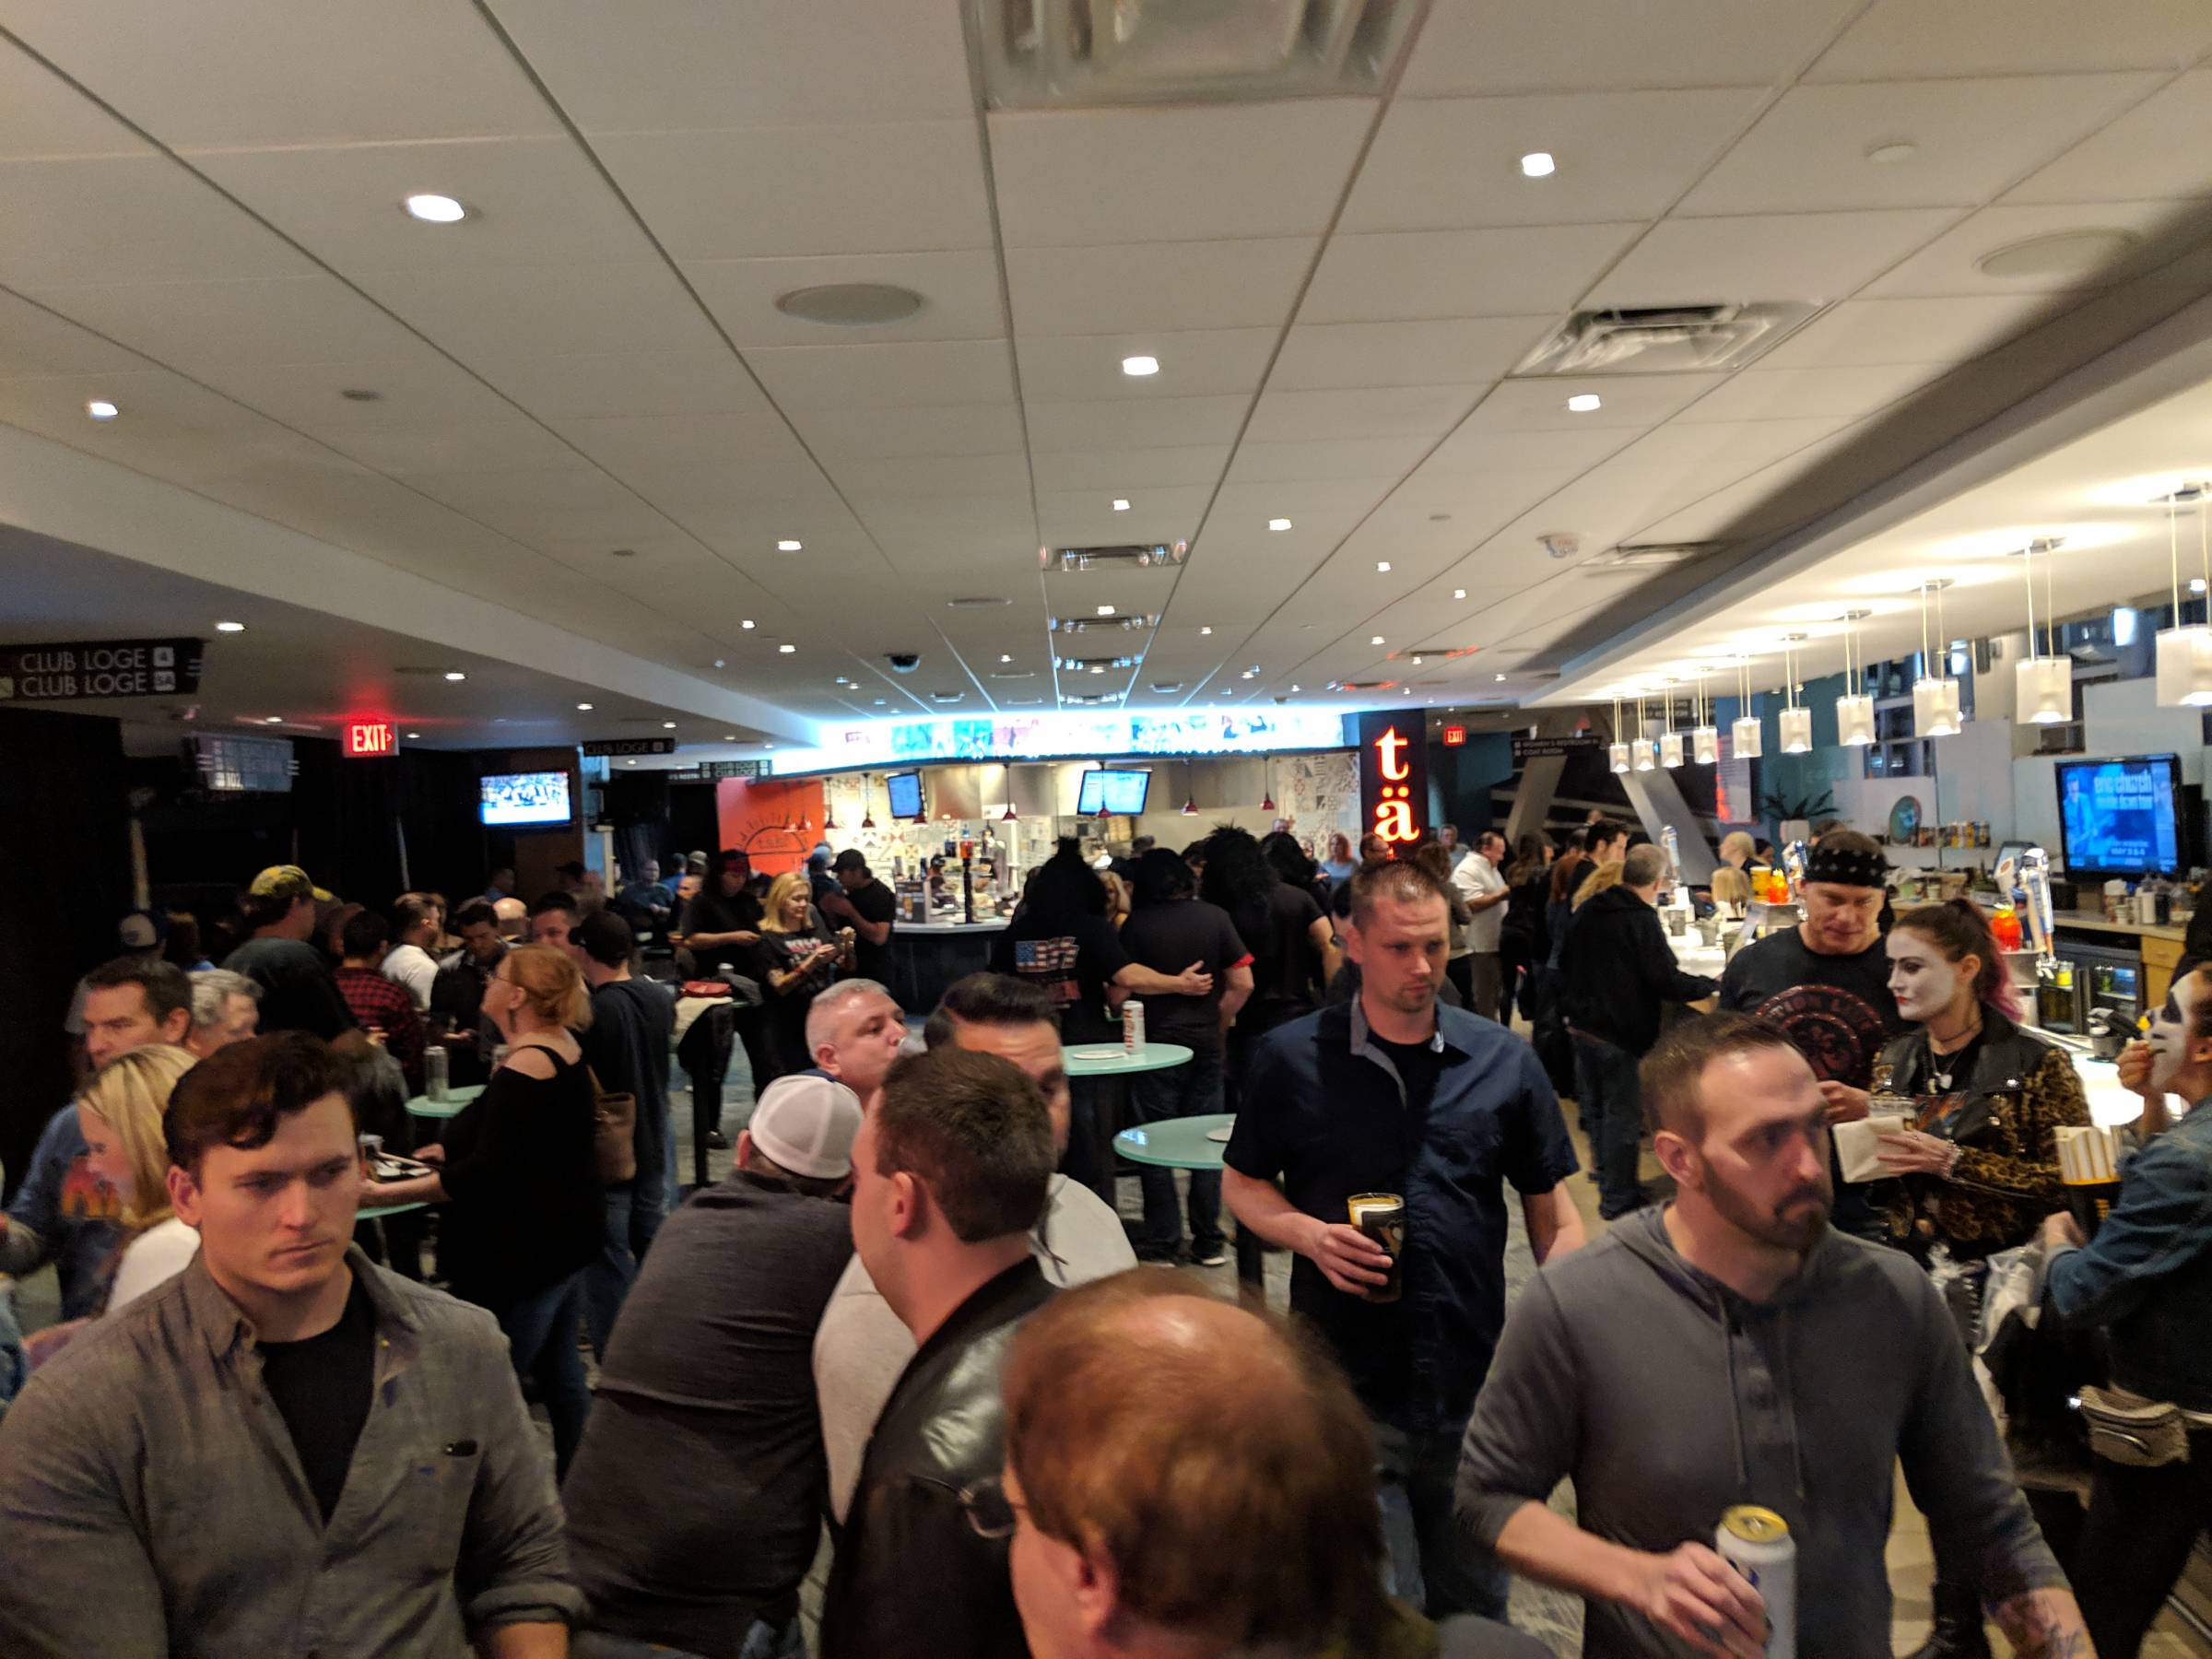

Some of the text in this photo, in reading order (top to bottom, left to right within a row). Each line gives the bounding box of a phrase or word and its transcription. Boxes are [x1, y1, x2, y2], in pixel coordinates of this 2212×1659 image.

[20, 651, 77, 673] CLUB
[84, 647, 147, 670] LOGE
[21, 675, 78, 698] CLUB
[84, 671, 148, 694] LOGE
[352, 724, 387, 752] EXIT
[1447, 729, 1463, 743] EXIT
[1373, 724, 1420, 858] tä
